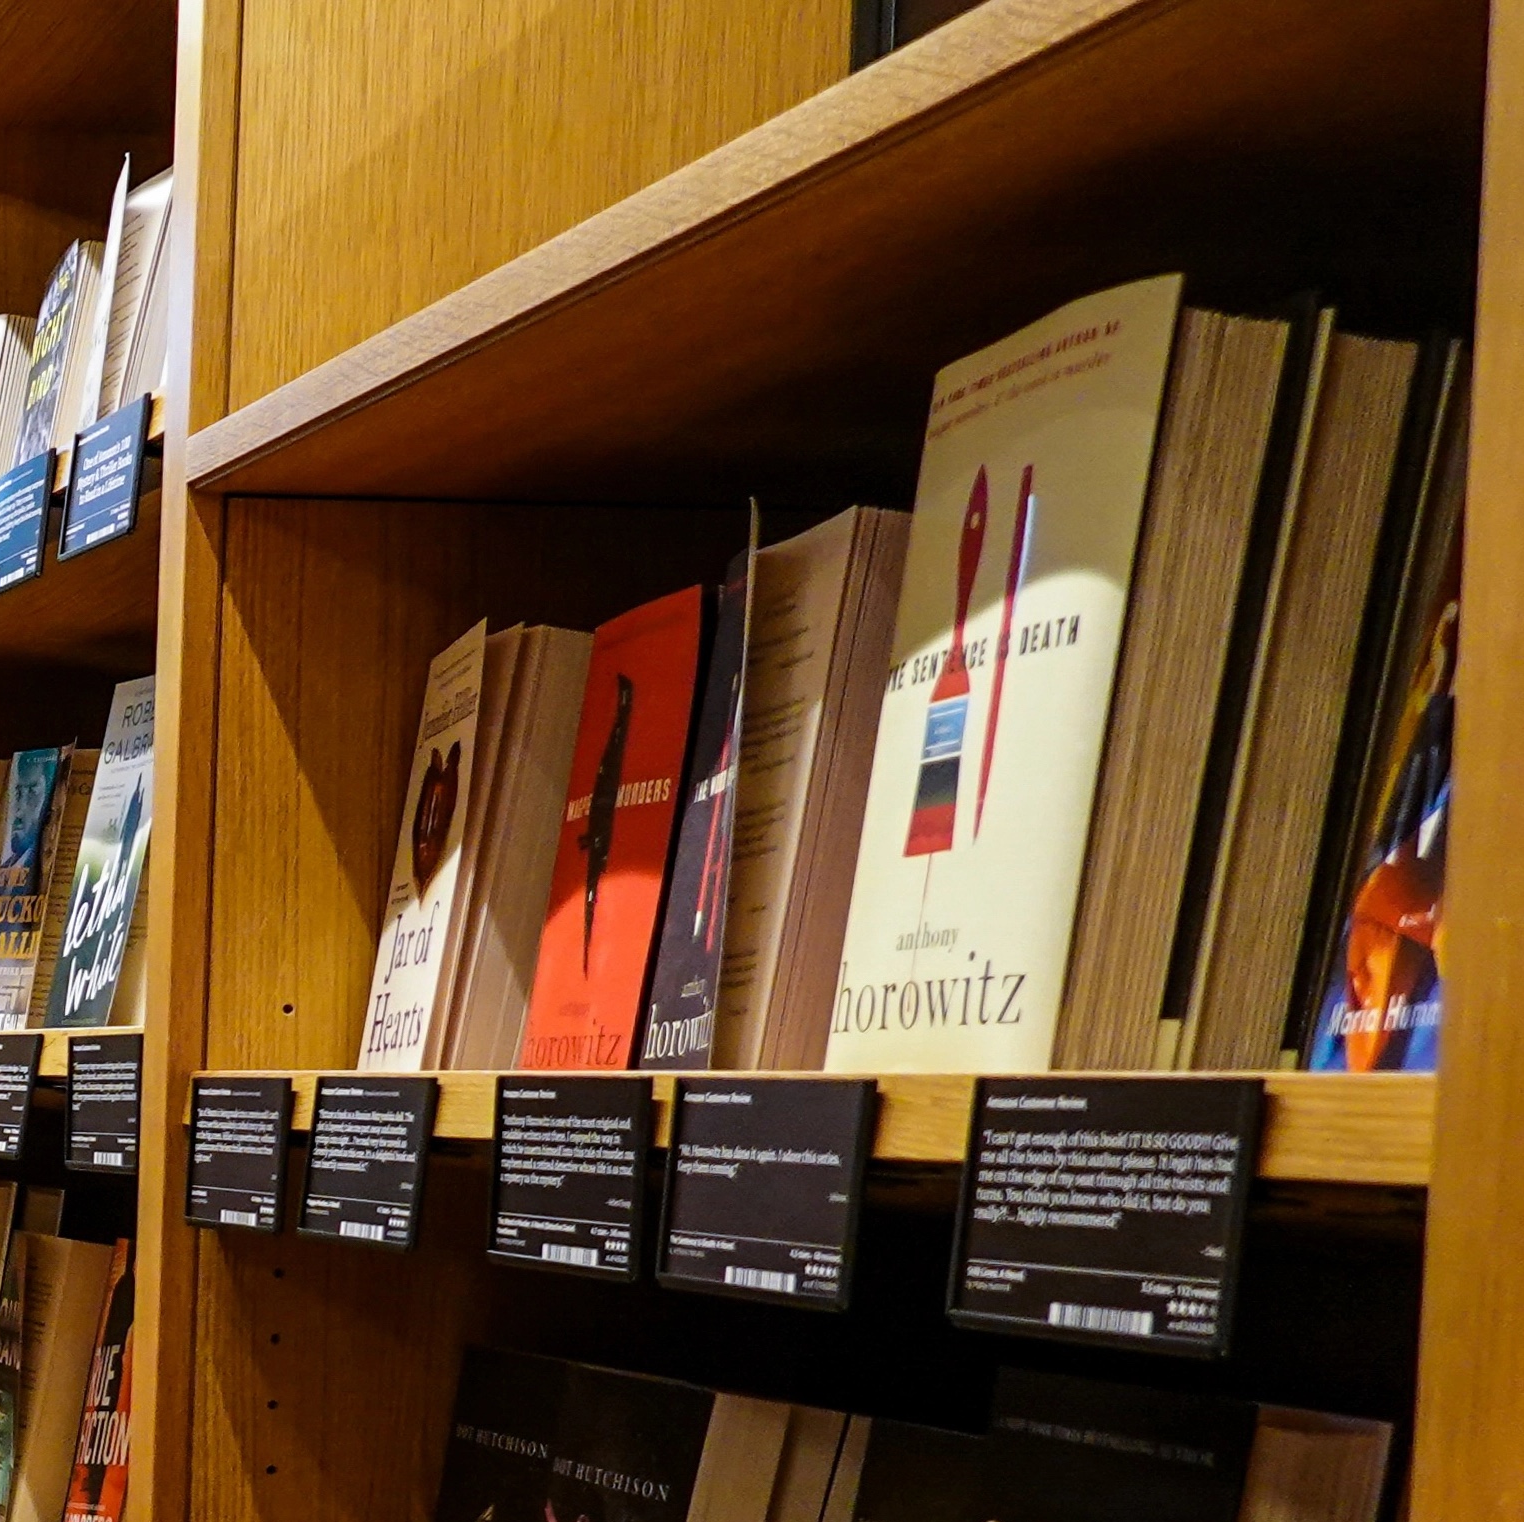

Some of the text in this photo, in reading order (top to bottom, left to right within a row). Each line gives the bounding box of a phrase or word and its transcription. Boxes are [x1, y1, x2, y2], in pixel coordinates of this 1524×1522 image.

[1018, 614, 1083, 656] DEATH
[385, 900, 440, 985] Jar of
[895, 921, 960, 953] anthony
[368, 992, 424, 1054] Hearts
[833, 951, 1028, 1034] horowitz
